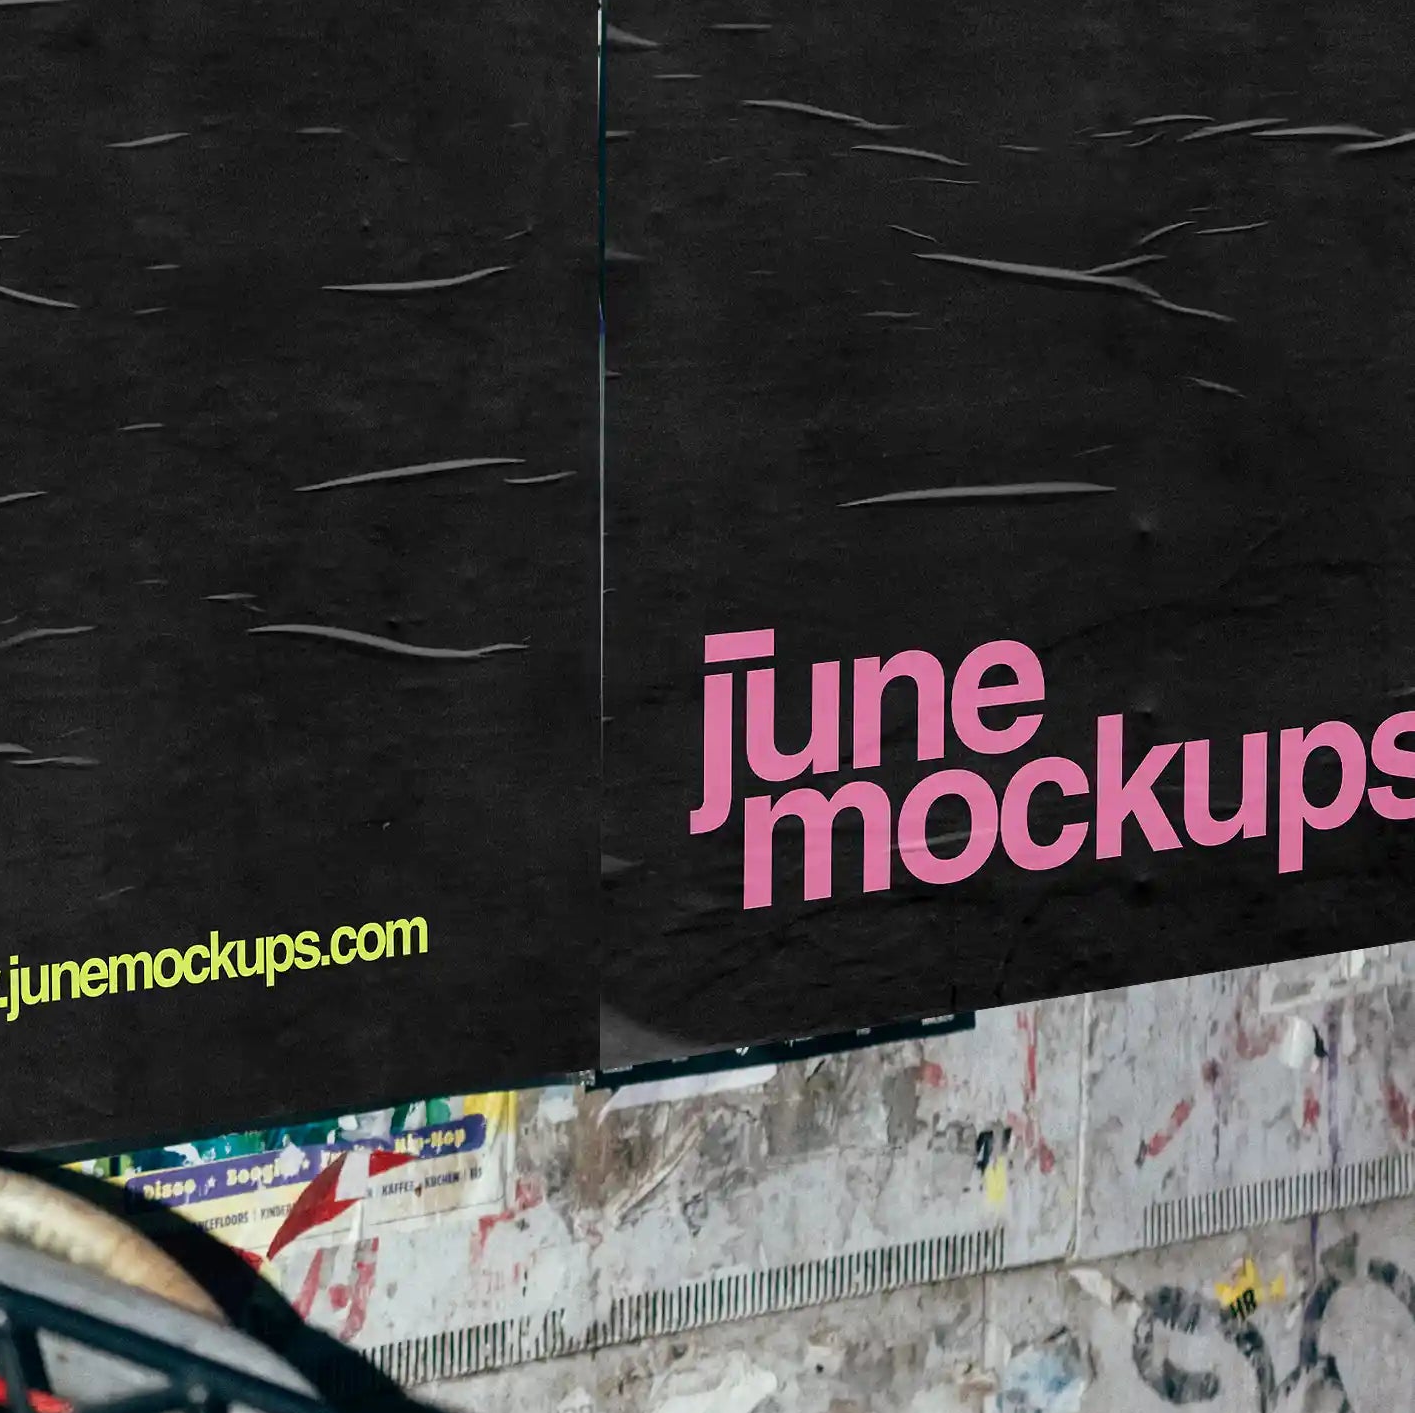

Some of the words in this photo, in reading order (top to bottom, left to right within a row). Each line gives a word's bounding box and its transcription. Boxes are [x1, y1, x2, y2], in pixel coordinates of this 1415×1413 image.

[689, 628, 1045, 834] june
[743, 709, 1415, 910] mockups
[226, 1160, 281, 1187] Boogi
